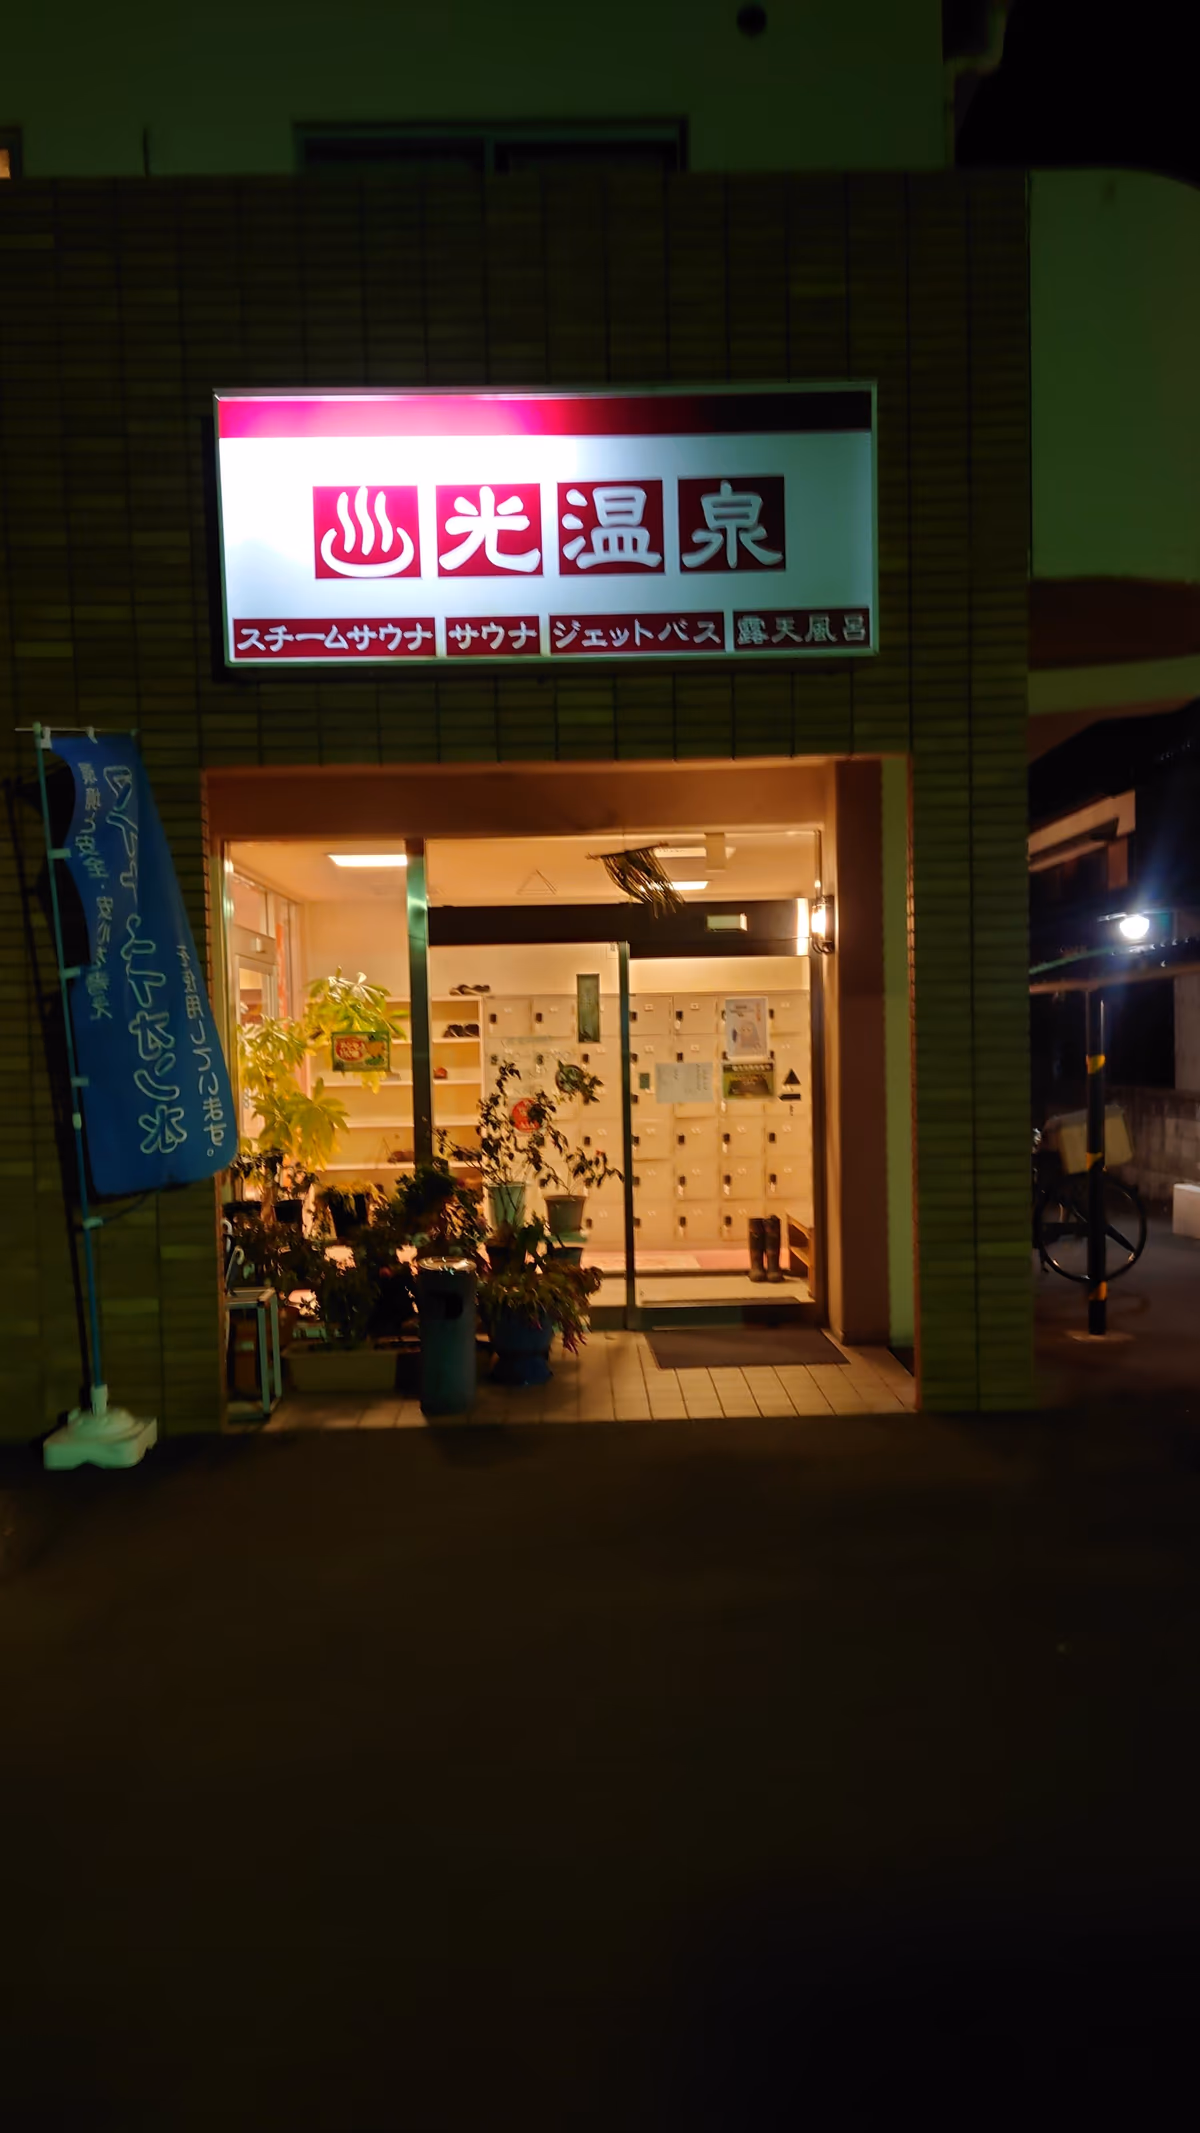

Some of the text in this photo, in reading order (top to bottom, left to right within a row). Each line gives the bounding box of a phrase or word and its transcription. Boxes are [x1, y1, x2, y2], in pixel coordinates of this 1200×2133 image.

[438, 480, 784, 573] 光温泉
[237, 614, 867, 652] スチームサウナ サウナ ジェットバス 露天風呂
